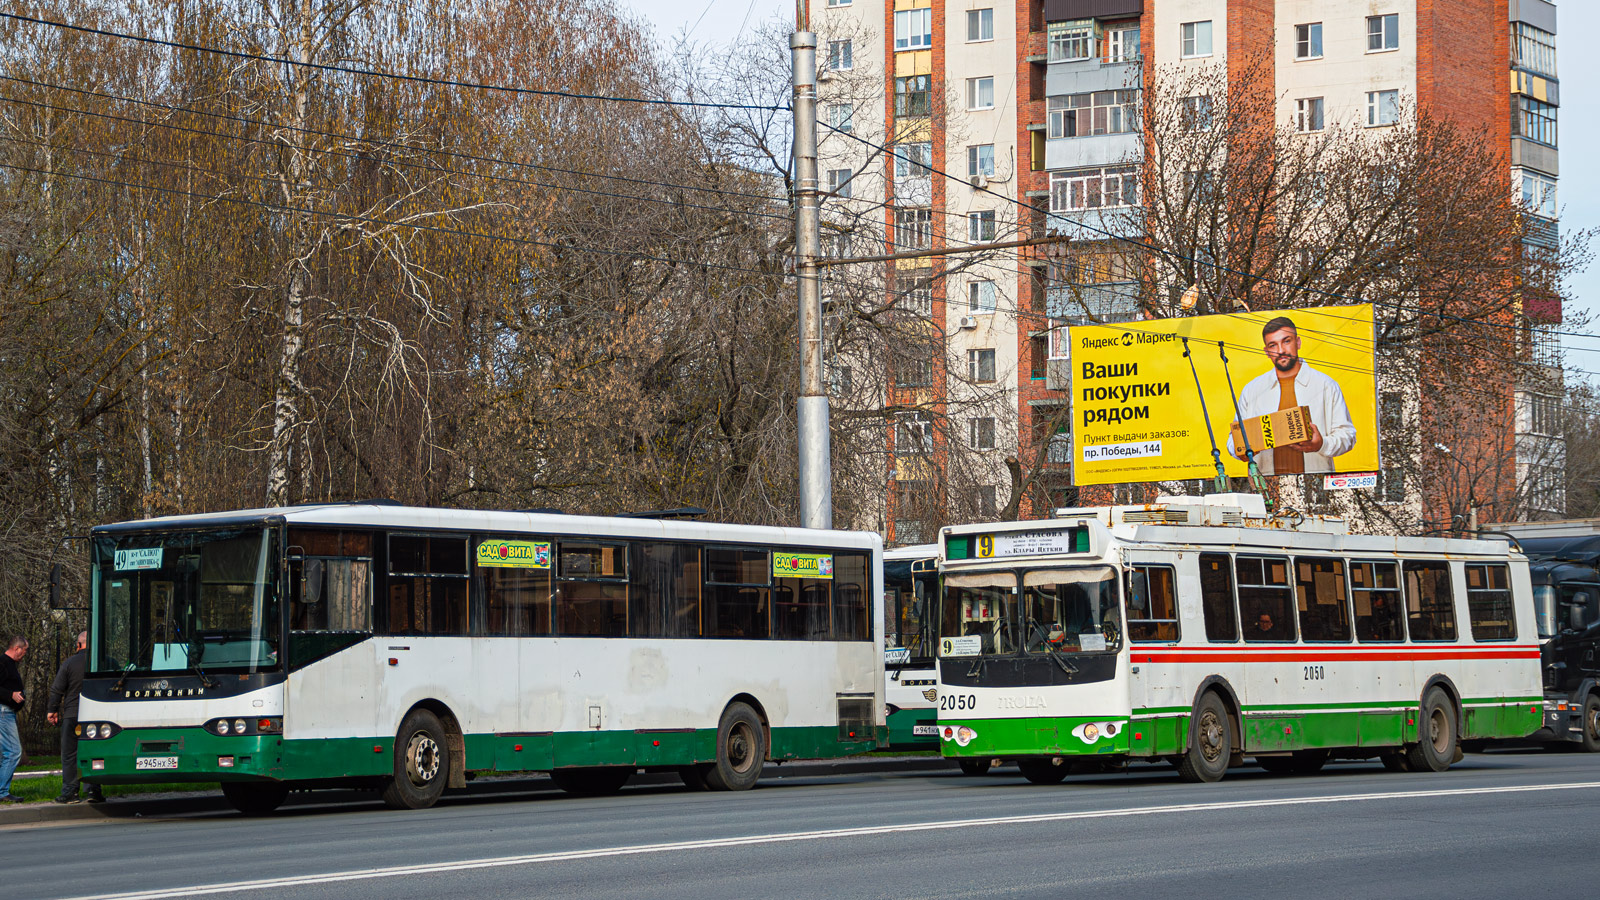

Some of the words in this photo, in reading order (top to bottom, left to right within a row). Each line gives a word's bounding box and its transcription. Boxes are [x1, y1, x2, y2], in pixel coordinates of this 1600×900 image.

[1082, 337, 1119, 349] Яндекс
[1136, 332, 1177, 345] Маркет
[1082, 361, 1138, 380] Ваши
[1083, 382, 1170, 403] покупки
[1083, 405, 1149, 427] рядом
[1293, 410, 1304, 439] Маркет
[1286, 411, 1296, 441] Яндекс
[1083, 434, 1111, 445] Пункт
[1113, 431, 1147, 442] выдачи
[1149, 429, 1190, 439] заказов:
[1084, 450, 1099, 458] пр.
[1101, 446, 1142, 457] Победы,
[1143, 443, 1161, 453] 144
[1347, 476, 1375, 487] 290-690
[981, 535, 993, 557] 9
[115, 550, 126, 570] 49
[943, 639, 952, 654] 9
[1303, 665, 1325, 681] 2050
[940, 694, 976, 711] 2050
